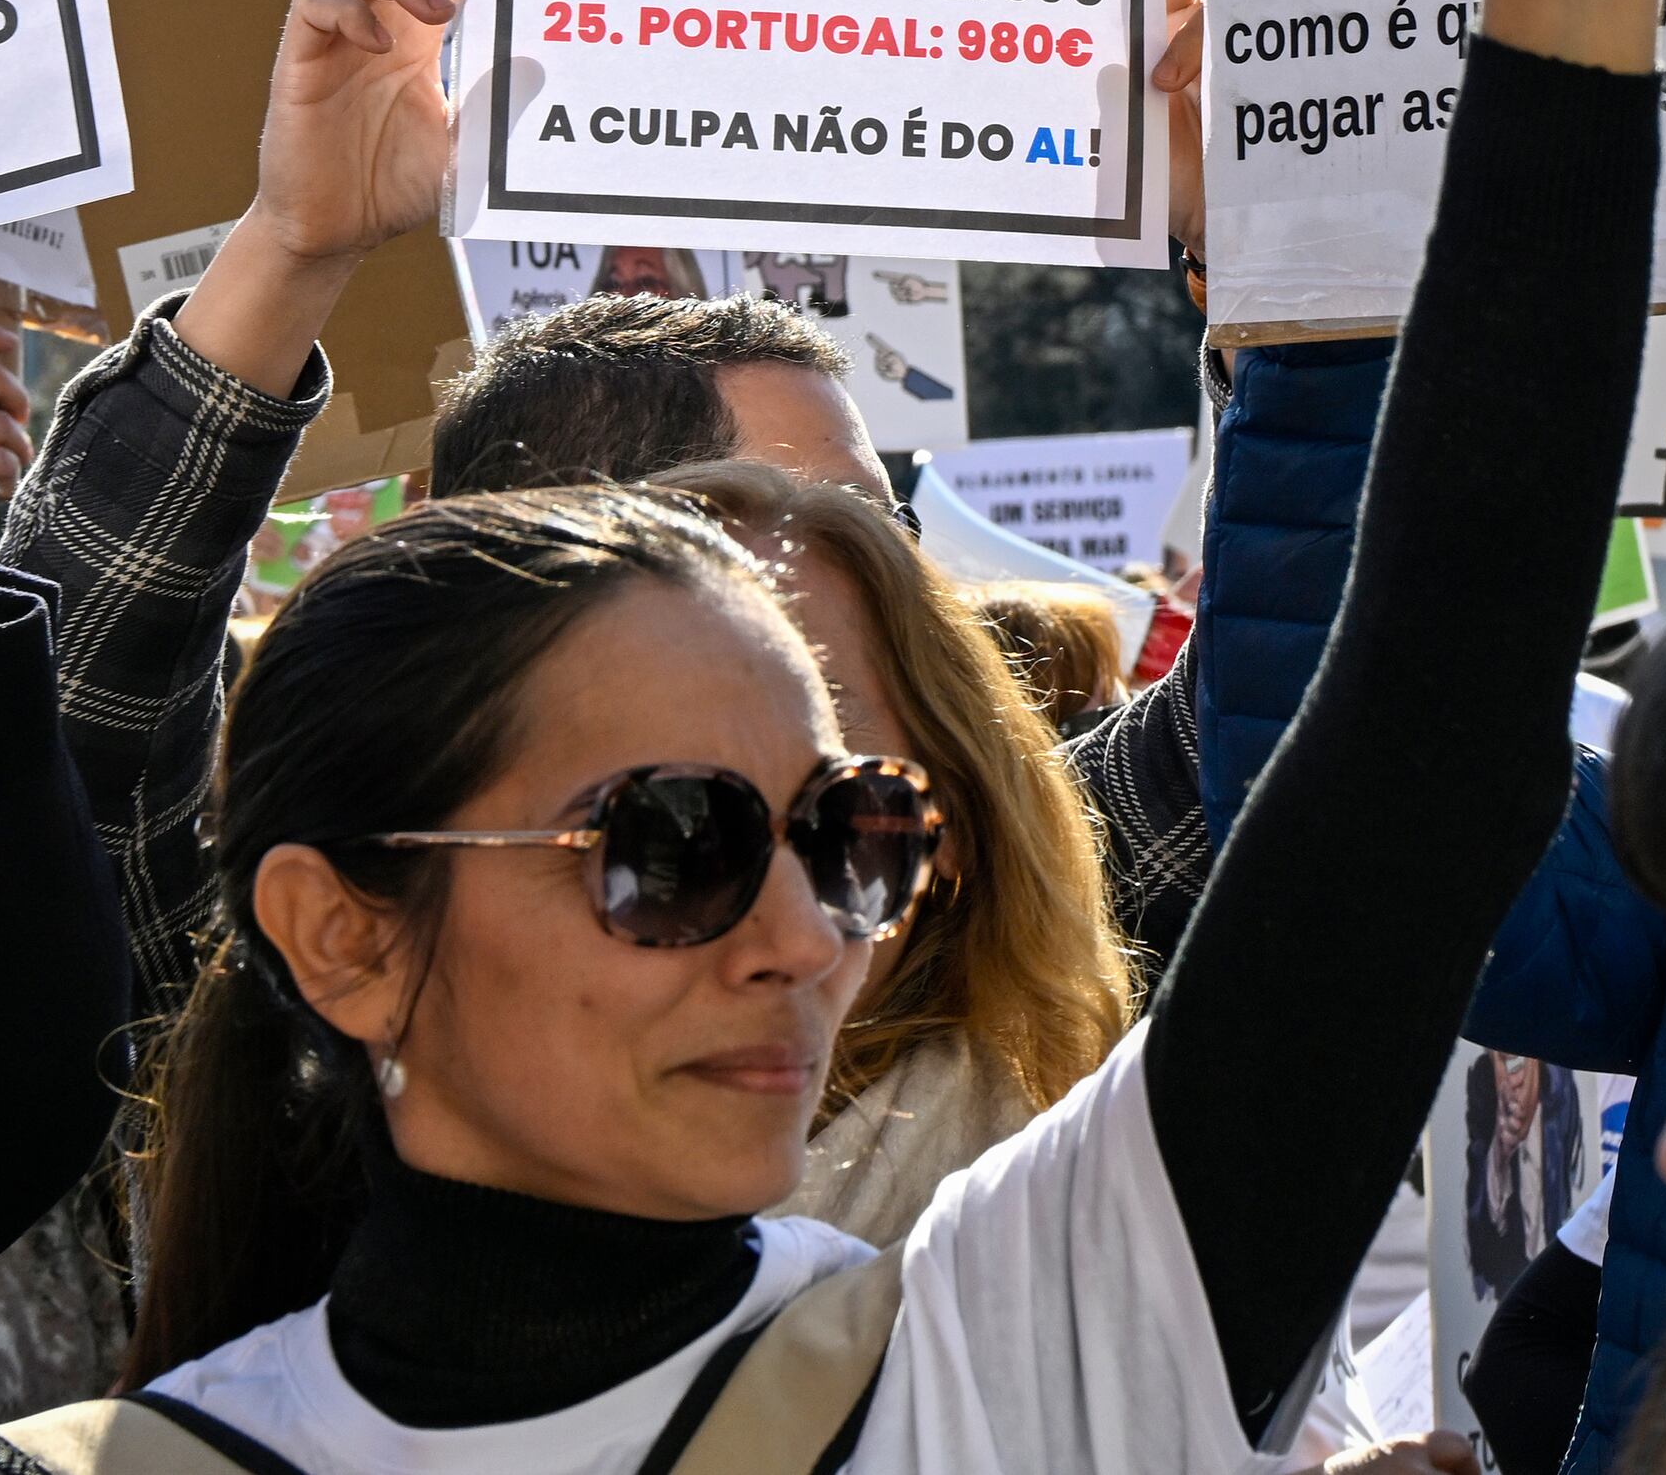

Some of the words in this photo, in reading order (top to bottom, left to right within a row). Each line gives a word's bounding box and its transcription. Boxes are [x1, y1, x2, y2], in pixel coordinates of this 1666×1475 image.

[543, 2, 623, 45] 25.
[639, 7, 944, 60] PORTUGAL:
[958, 20, 1093, 67] 980€
[1224, 11, 1370, 65] como
[539, 104, 576, 143] A
[589, 106, 756, 151] CULPA
[773, 105, 888, 156] NÃO
[902, 106, 927, 158] É
[940, 124, 1014, 163] DO
[1025, 127, 1102, 168] AL!
[1235, 92, 1384, 161] pagar
